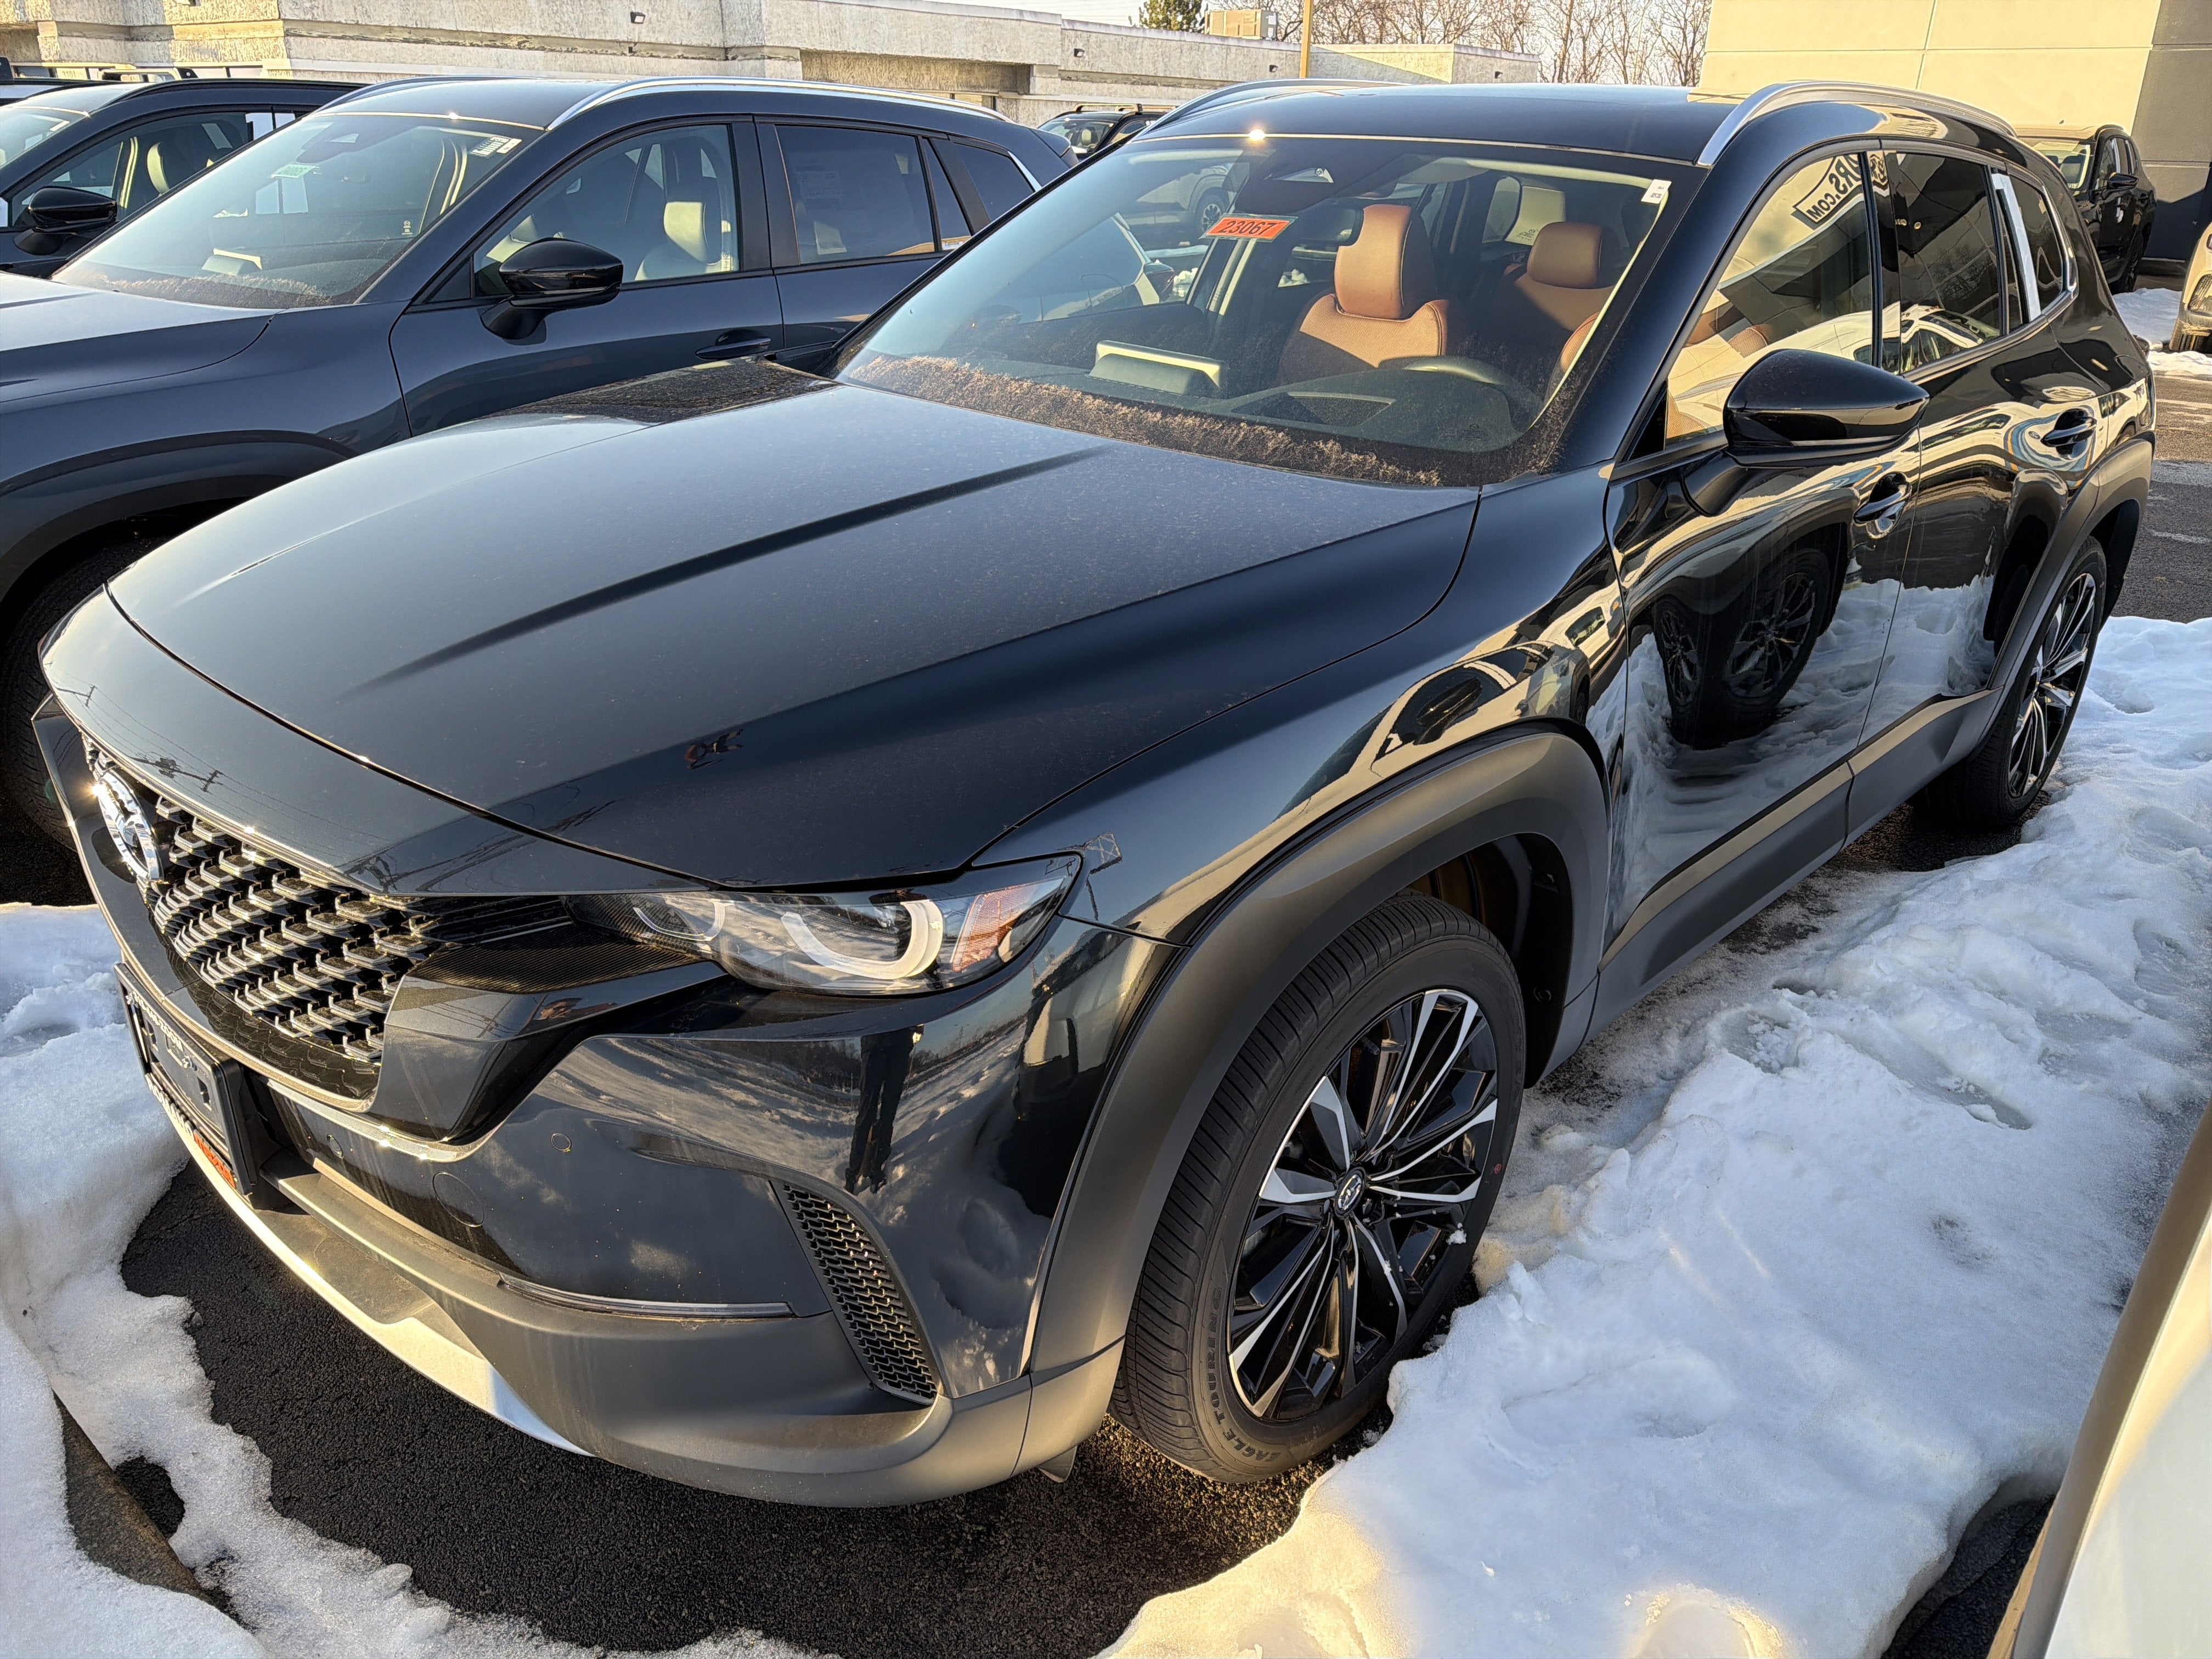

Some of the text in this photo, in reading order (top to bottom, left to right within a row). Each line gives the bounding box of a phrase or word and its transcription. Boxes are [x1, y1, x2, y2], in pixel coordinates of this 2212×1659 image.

[1217, 220, 1277, 235] 23067
[1207, 1288, 1282, 1462] EAGLE TOURING
